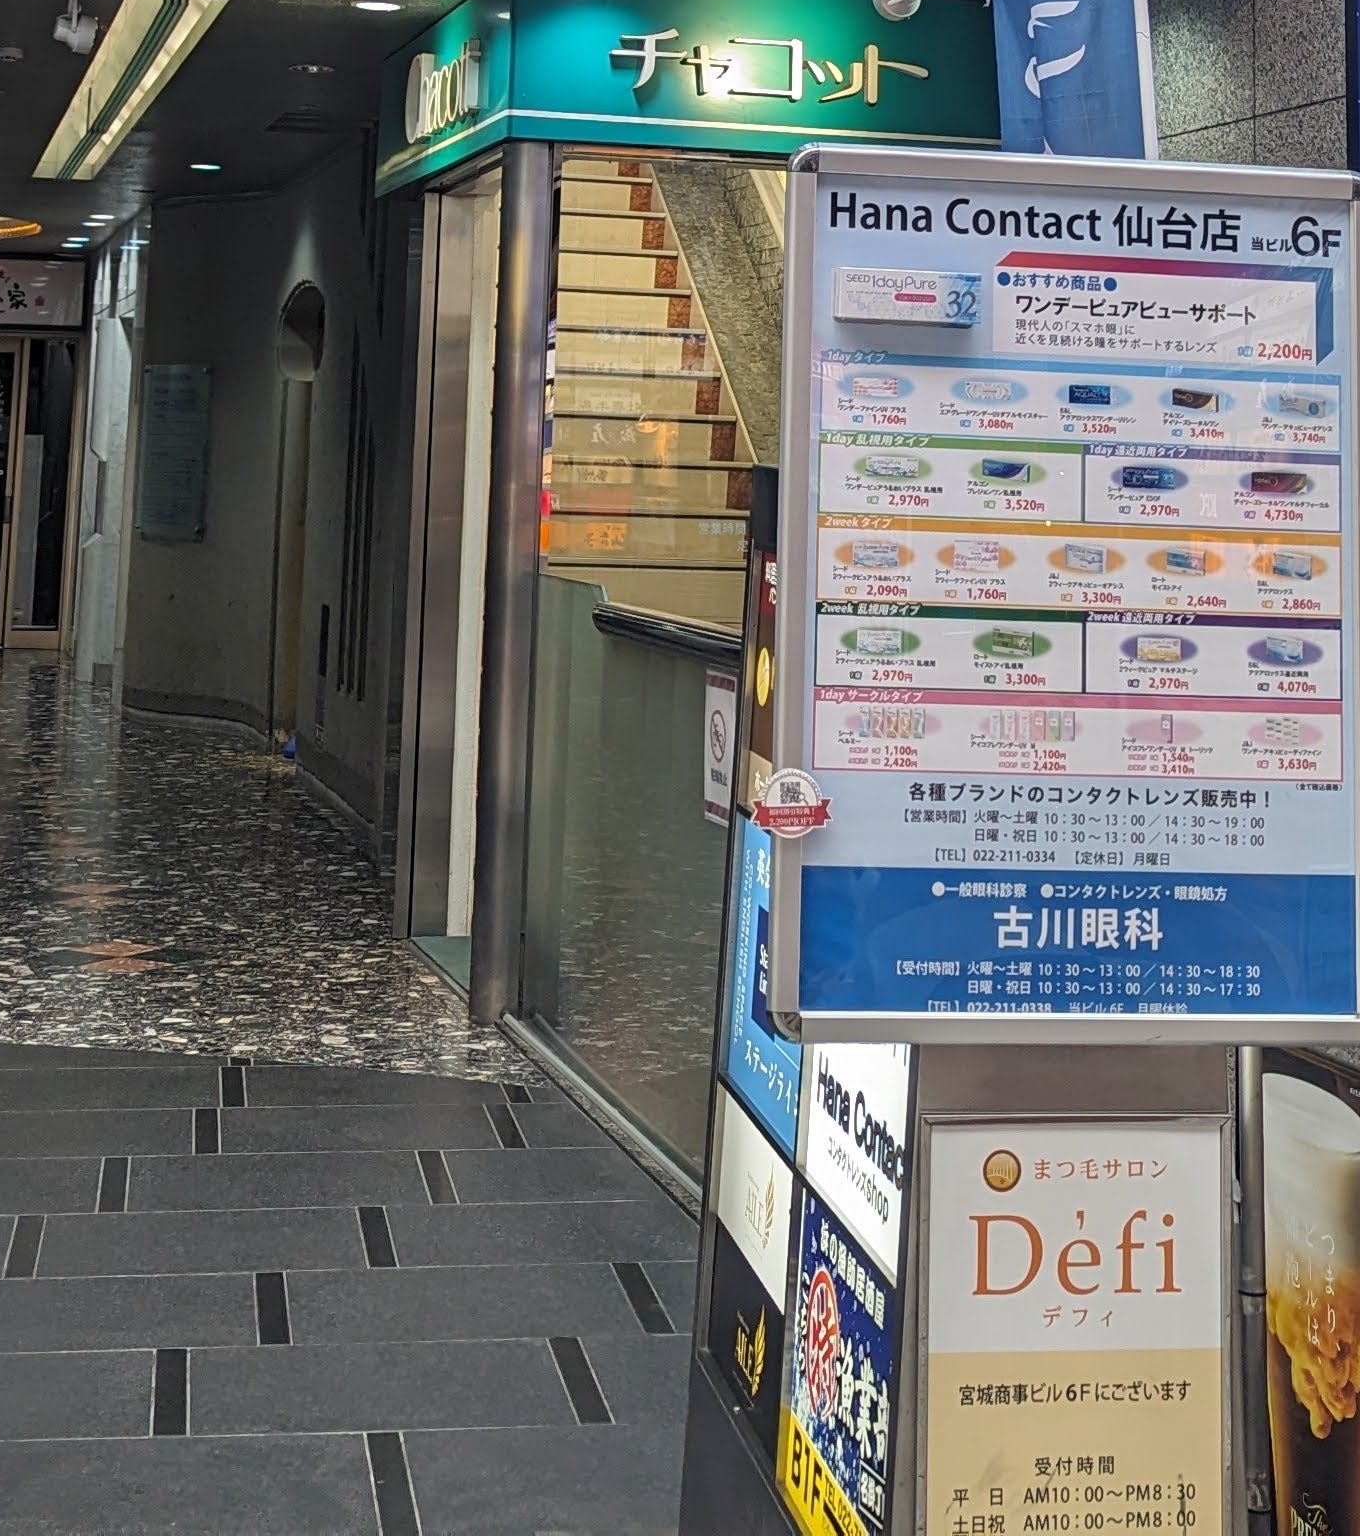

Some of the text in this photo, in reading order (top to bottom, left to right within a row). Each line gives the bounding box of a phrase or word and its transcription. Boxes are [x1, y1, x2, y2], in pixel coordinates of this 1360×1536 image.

[610, 27, 930, 108] チャコット
[829, 191, 933, 234] Hana
[945, 197, 1101, 243] Contact
[1113, 202, 1241, 254] 仙台店
[846, 273, 871, 283] SEED
[946, 291, 977, 319] 32
[1015, 294, 1257, 325] ワンデーピュアビューサポート
[827, 351, 887, 363] 1day タイプ
[1257, 342, 1312, 361] 2,200円
[871, 415, 907, 426] 1,760円
[978, 419, 1014, 430] 3,080円
[1082, 423, 1117, 435] 3,520円
[1189, 428, 1224, 440] 3,410円
[826, 433, 853, 447] 1day
[1292, 433, 1325, 444] 3,740円
[1090, 444, 1113, 457] 1day
[888, 495, 929, 507] 2,970円
[1005, 499, 1045, 512] 3,520円
[1140, 505, 1180, 517] 2,970円
[1264, 510, 1303, 522] 4,730円
[825, 516, 893, 528] 2week タイプ
[866, 585, 907, 598] 2,090円
[967, 588, 1007, 601] 1,760円
[1082, 592, 1122, 604] 3,300円
[821, 603, 853, 614] 2week
[1187, 596, 1227, 608] 2,640円
[1282, 599, 1321, 611] 2,860円
[1087, 612, 1120, 622] 2week
[871, 670, 913, 683] 2,970円
[1005, 674, 1046, 686] 3,300円
[1148, 678, 1189, 690] 2,970円
[1277, 681, 1316, 694] 4,070円
[820, 689, 845, 702] 1day
[1277, 759, 1317, 771] 3,630円
[973, 851, 1170, 866] 022-211-0334 月曜日
[993, 906, 1163, 951] 古川眼科
[745, 1040, 799, 1117] ステージライ
[817, 1051, 851, 1135] Hana
[1034, 1158, 1169, 1180] まつ毛サロン
[1043, 1305, 1114, 1328] デフィ
[959, 1380, 1192, 1406] 宮城商事ビル6Fにございます
[1034, 1456, 1115, 1477] 受付時間
